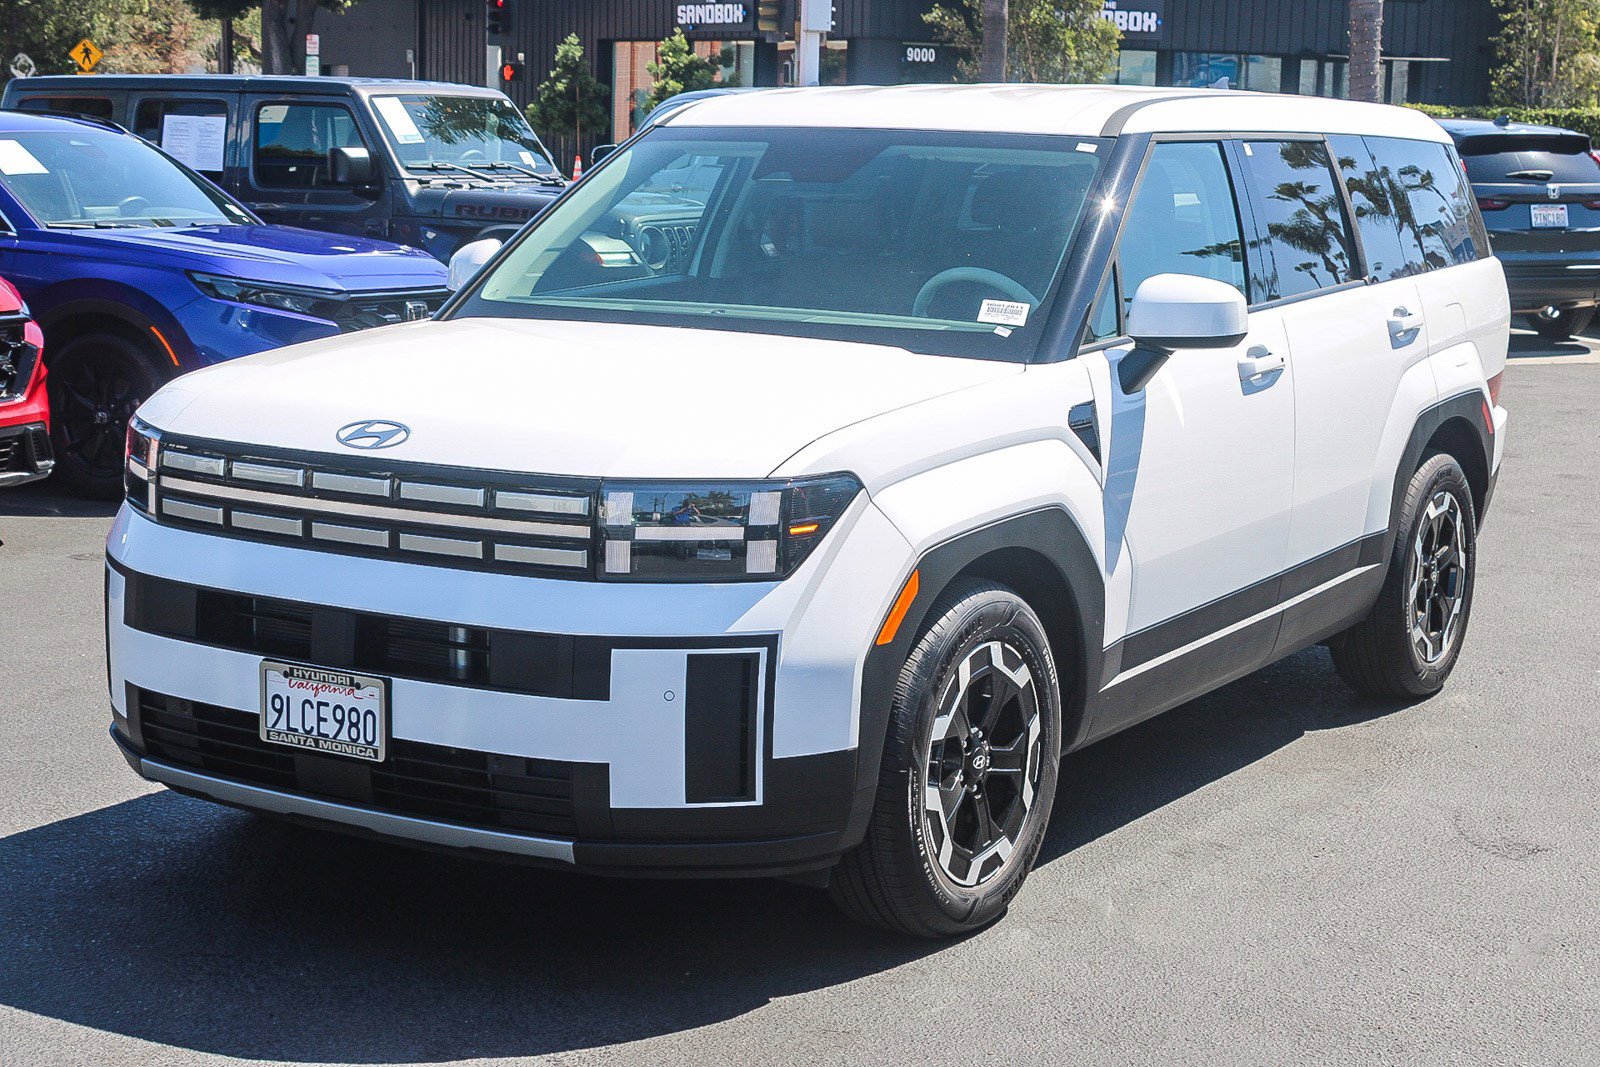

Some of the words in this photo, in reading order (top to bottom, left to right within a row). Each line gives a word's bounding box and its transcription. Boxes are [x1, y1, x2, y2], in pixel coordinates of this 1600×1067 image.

[677, 4, 743, 24] SANDBOX
[906, 47, 936, 62] 9000
[293, 668, 351, 686] HYUNDAI
[271, 693, 377, 746] 9LCE980
[269, 731, 316, 748] SANTA
[318, 740, 375, 758] MONICA
